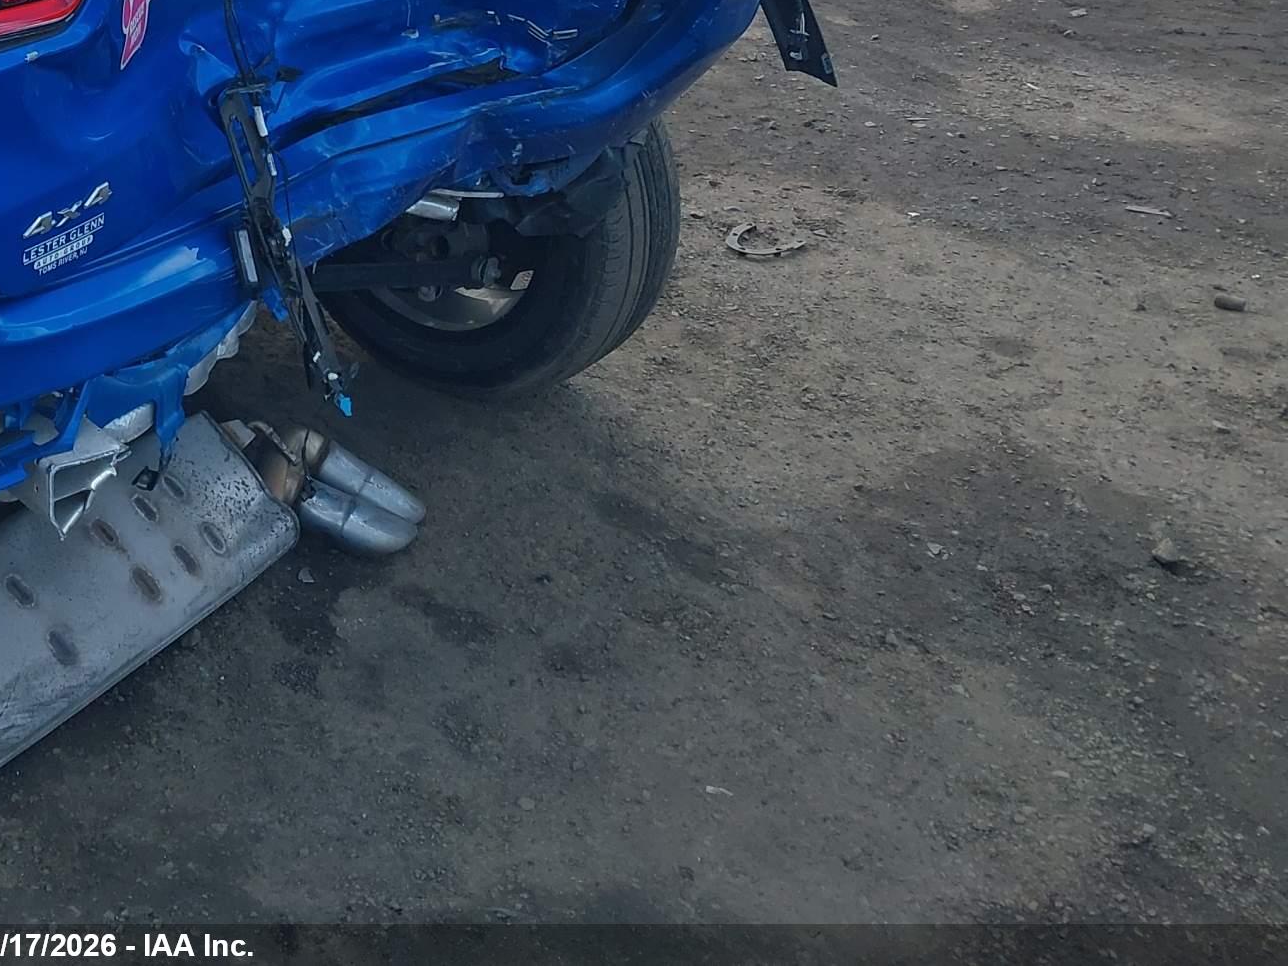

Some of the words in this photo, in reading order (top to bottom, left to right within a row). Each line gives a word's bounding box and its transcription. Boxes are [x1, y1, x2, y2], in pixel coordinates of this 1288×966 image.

[23, 235, 66, 263] LESTER
[70, 214, 104, 240] GLENN
[36, 251, 59, 268] AUTO
[39, 261, 57, 275] TOMS
[79, 246, 88, 255] NJ
